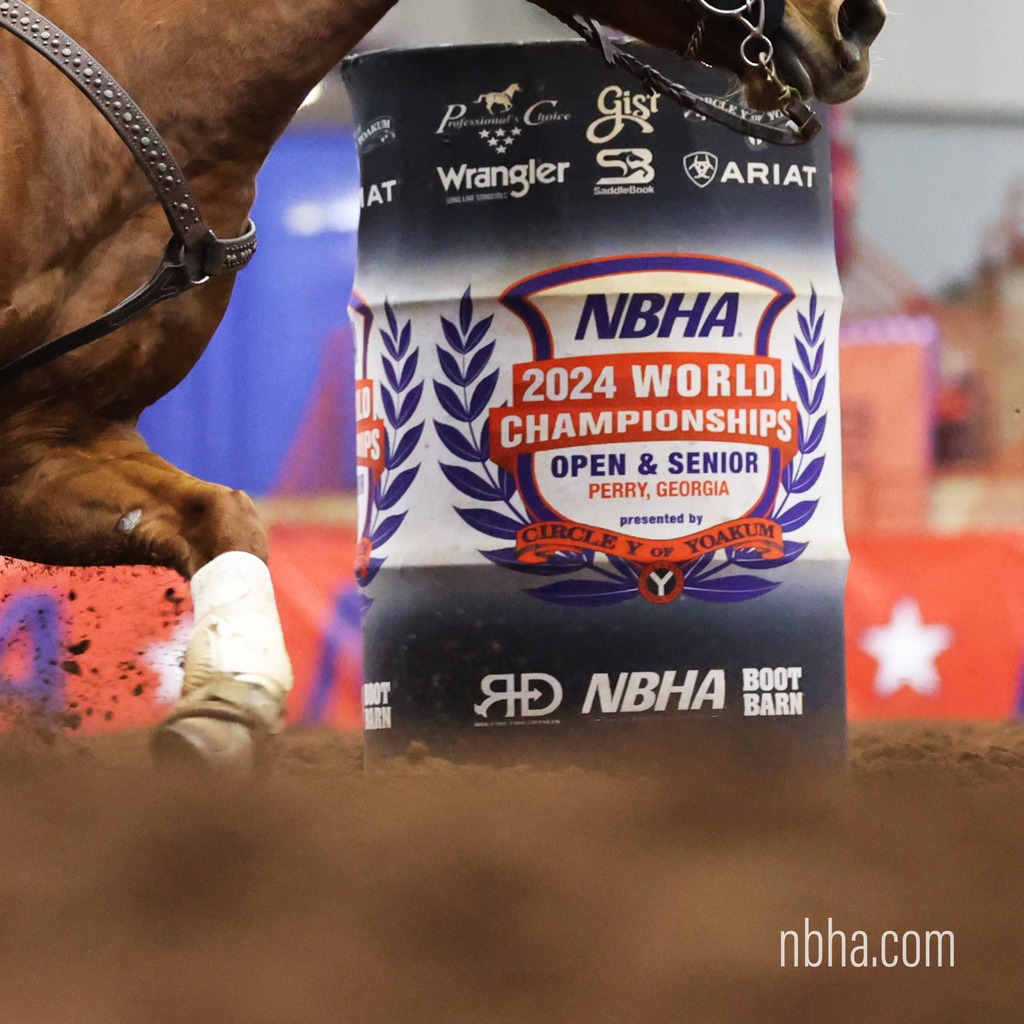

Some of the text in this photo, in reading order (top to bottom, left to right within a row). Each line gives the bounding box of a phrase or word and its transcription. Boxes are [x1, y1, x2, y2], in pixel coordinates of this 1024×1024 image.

[523, 99, 571, 126] Choice
[586, 85, 661, 144] Gist
[436, 158, 571, 198] Wrangler
[720, 161, 817, 188] ARIAT
[594, 185, 655, 195] SaddleBook
[574, 292, 740, 341] NBHA
[521, 363, 777, 402] 2024 WORLD
[500, 407, 792, 448] CHAMPIONSHIPS
[551, 451, 759, 478] OPEN & SENIOR
[588, 480, 730, 500] PERRY, GEORGIA
[620, 513, 703, 527] presented by
[521, 523, 776, 558] CIRCLE Y OF YOAKUM
[581, 669, 726, 714] NBHA
[742, 666, 803, 691] BOOT
[743, 692, 804, 717] BARN
